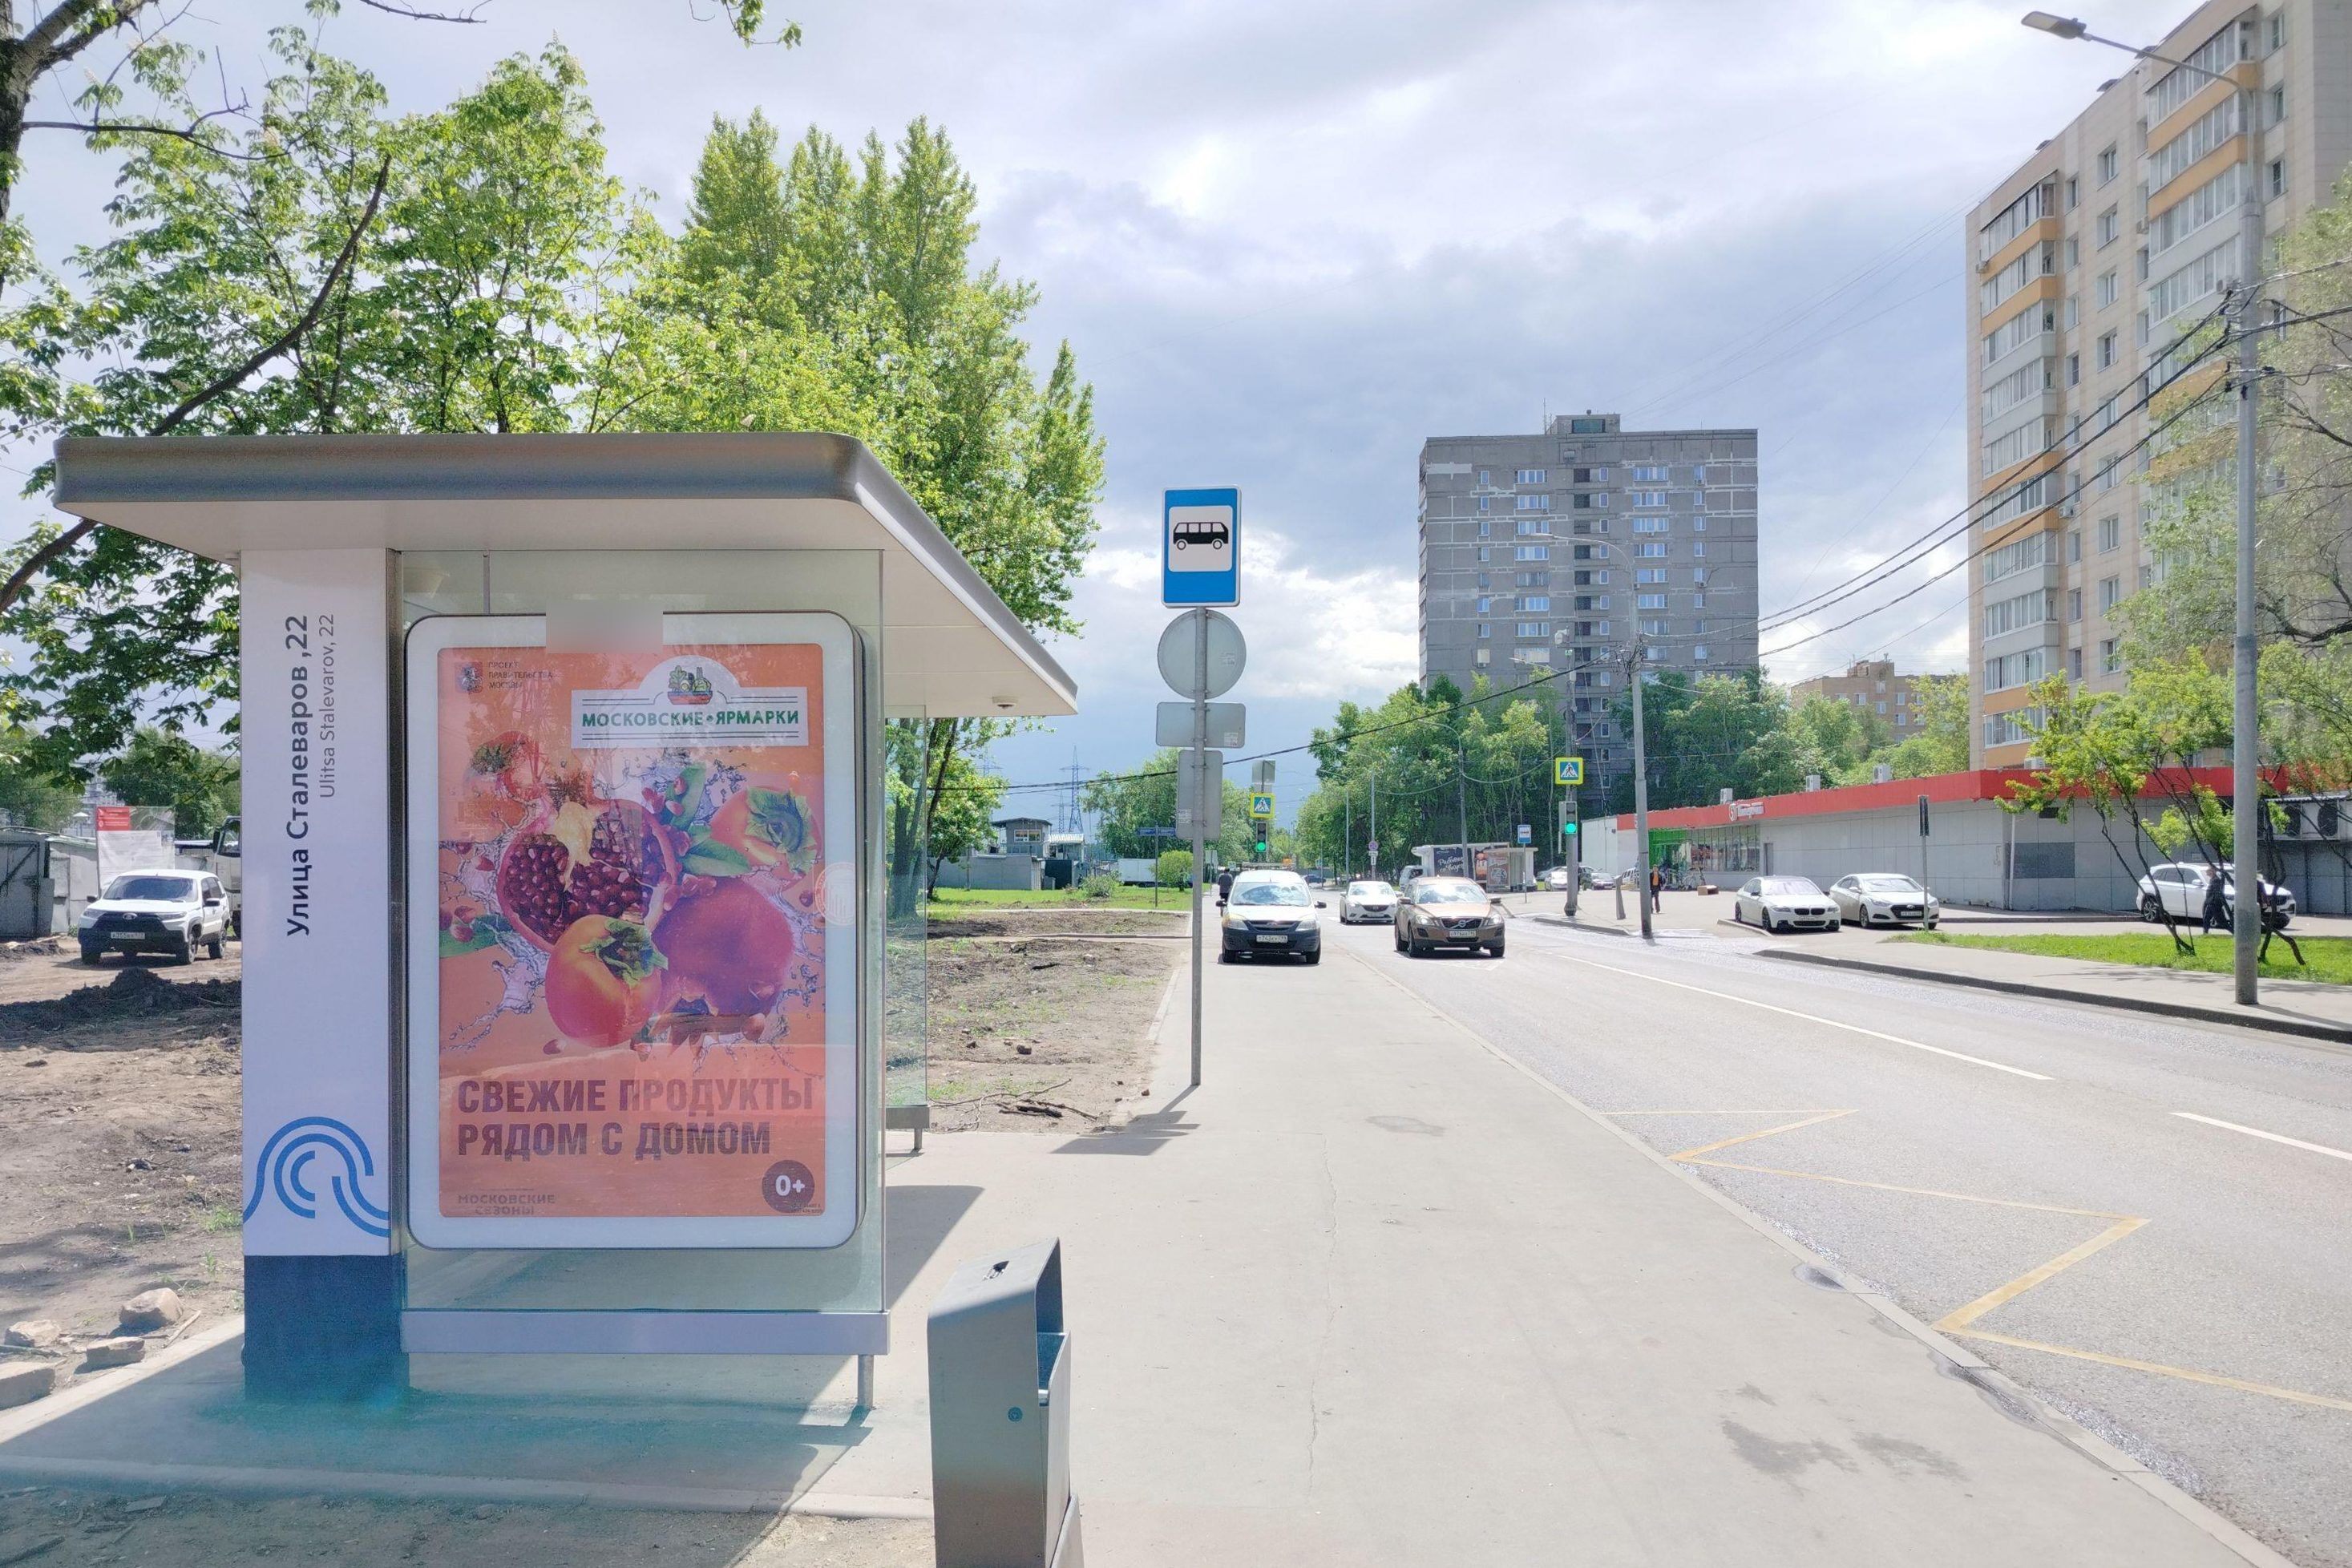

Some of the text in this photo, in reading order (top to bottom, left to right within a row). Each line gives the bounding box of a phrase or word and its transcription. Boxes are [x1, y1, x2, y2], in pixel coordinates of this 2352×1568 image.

[318, 613, 337, 798] Ulitsa Stalevarov, 22
[285, 666, 313, 839] Сталеваров
[286, 848, 313, 937] Улица
[457, 1077, 814, 1117] СВЕЖИЕ ПРОДУКТЫ
[457, 1121, 772, 1162] РЯДОМ С ДОМОМ
[457, 1194, 556, 1204] МОСКОВСКИЕ
[775, 1174, 806, 1197] 0+
[474, 1205, 535, 1215] СЕЗОНЫ
